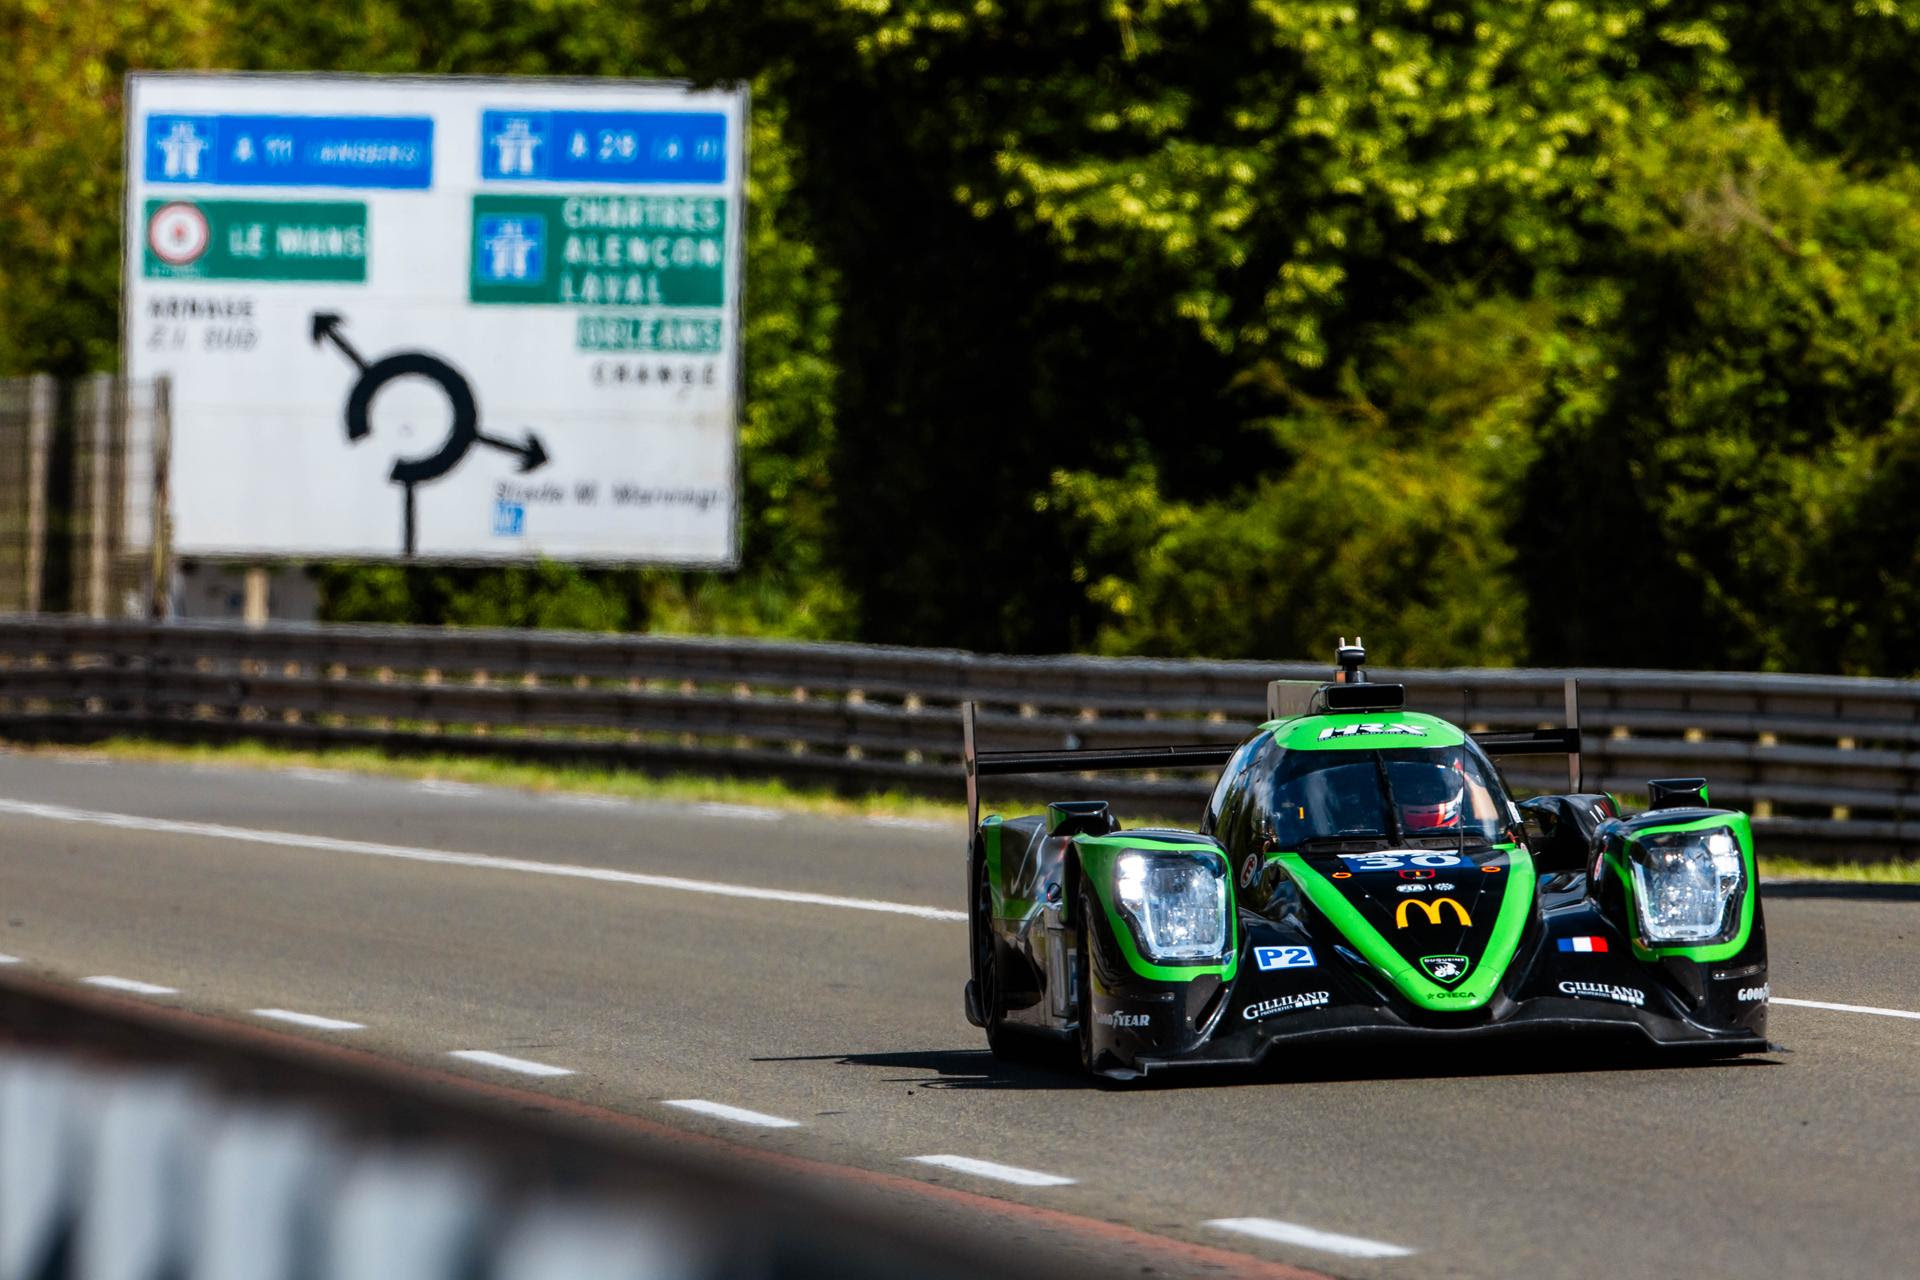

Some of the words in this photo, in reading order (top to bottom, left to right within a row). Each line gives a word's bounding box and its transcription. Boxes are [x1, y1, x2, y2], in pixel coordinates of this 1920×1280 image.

[229, 223, 264, 257] LE
[276, 225, 367, 258] MANS
[560, 272, 663, 304] LAVAL
[1357, 855, 1461, 870] 30
[1258, 949, 1311, 967] P2
[1558, 981, 1645, 999] GILLILAND
[1242, 991, 1330, 1020] GILLILAND
